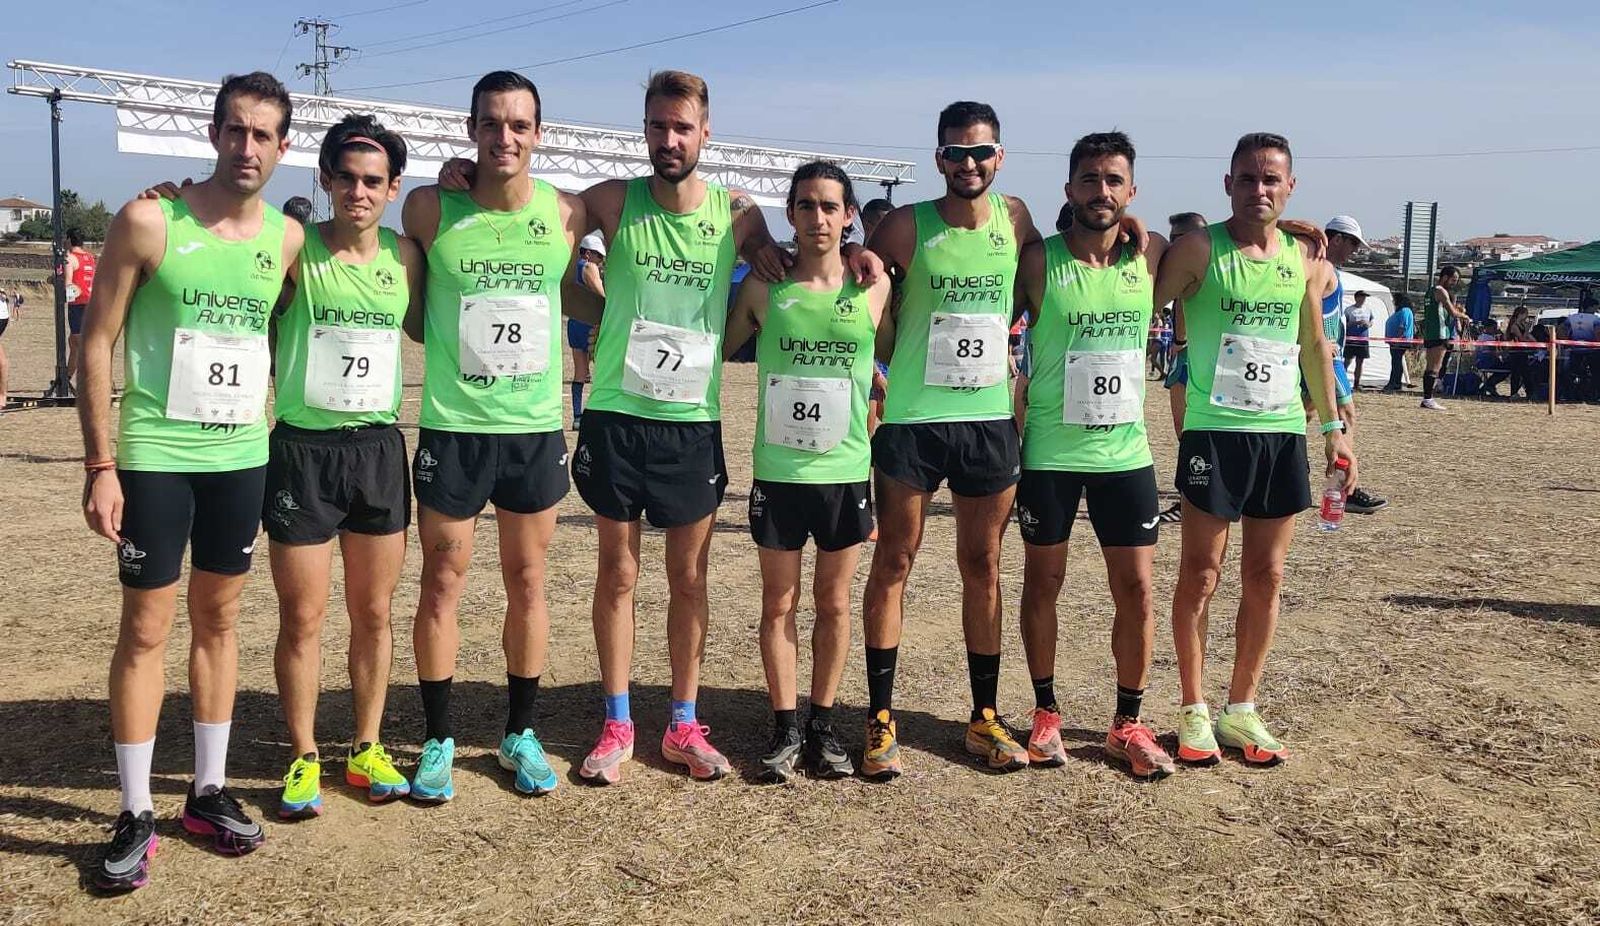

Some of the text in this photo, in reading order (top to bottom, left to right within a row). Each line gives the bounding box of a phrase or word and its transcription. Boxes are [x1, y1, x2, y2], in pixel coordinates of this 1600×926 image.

[461, 259, 544, 276] Universo
[636, 251, 713, 274] Universo
[476, 276, 542, 293] Running
[647, 270, 711, 291] Running
[931, 275, 1004, 290] Universo
[183, 288, 269, 314] Universo
[943, 289, 1002, 304] Running
[1221, 298, 1293, 314] Universo
[196, 309, 266, 332] Running
[313, 304, 395, 324] Universo
[1069, 311, 1140, 325] Universo
[1232, 314, 1289, 330] Running
[491, 323, 522, 345] 78
[1081, 325, 1138, 339] Running
[780, 337, 858, 354] Universo
[956, 339, 984, 358] 83
[341, 356, 370, 379] 79
[655, 349, 685, 372] 77
[792, 354, 855, 370] Running
[208, 362, 241, 387] 81
[1245, 363, 1271, 383] 85
[1093, 376, 1121, 395] 80
[792, 402, 822, 423] 84
